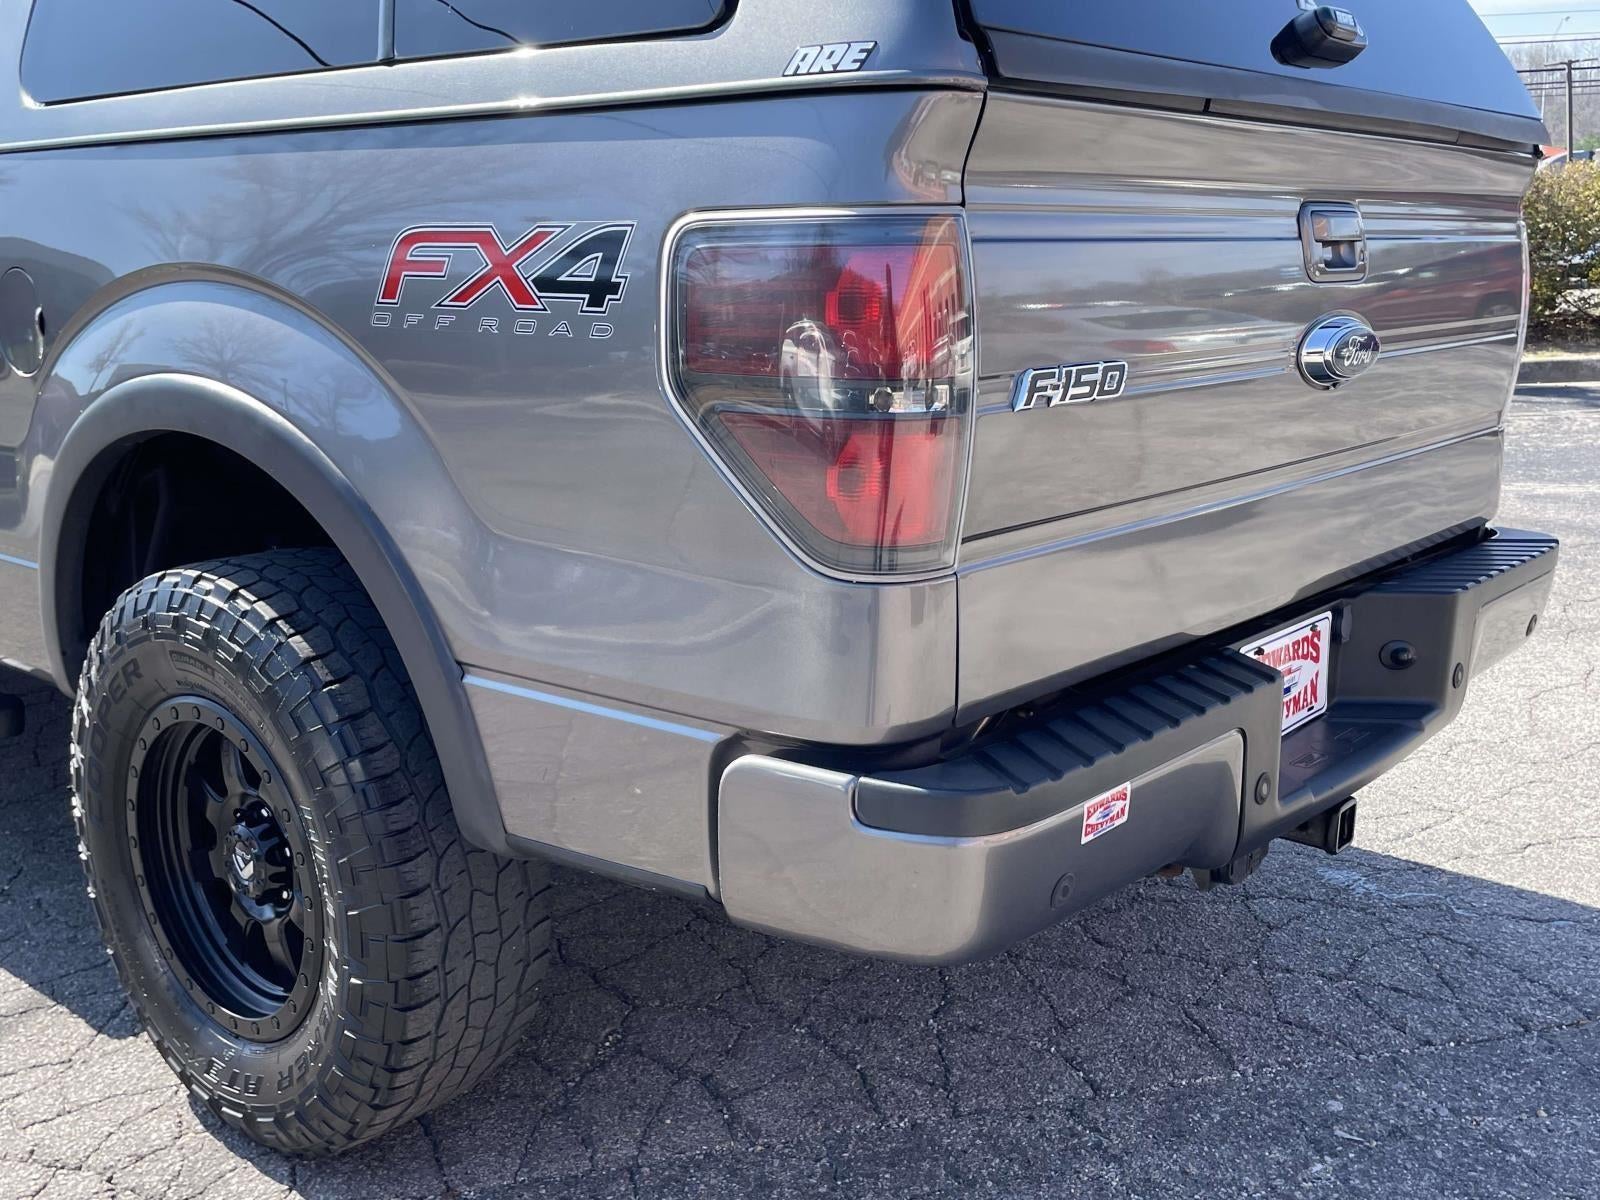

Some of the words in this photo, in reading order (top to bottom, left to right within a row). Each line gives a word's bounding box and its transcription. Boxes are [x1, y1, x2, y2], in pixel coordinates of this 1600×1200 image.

[782, 41, 877, 77] ARE
[375, 220, 638, 316] FX4
[371, 312, 456, 330] OFF
[478, 316, 614, 339] ROAD
[1341, 335, 1375, 367] Ford
[1013, 361, 1129, 411] F-150
[1256, 630, 1321, 669] DWARDS
[1281, 669, 1320, 719] YMAN
[1085, 786, 1128, 821] EDWARDS
